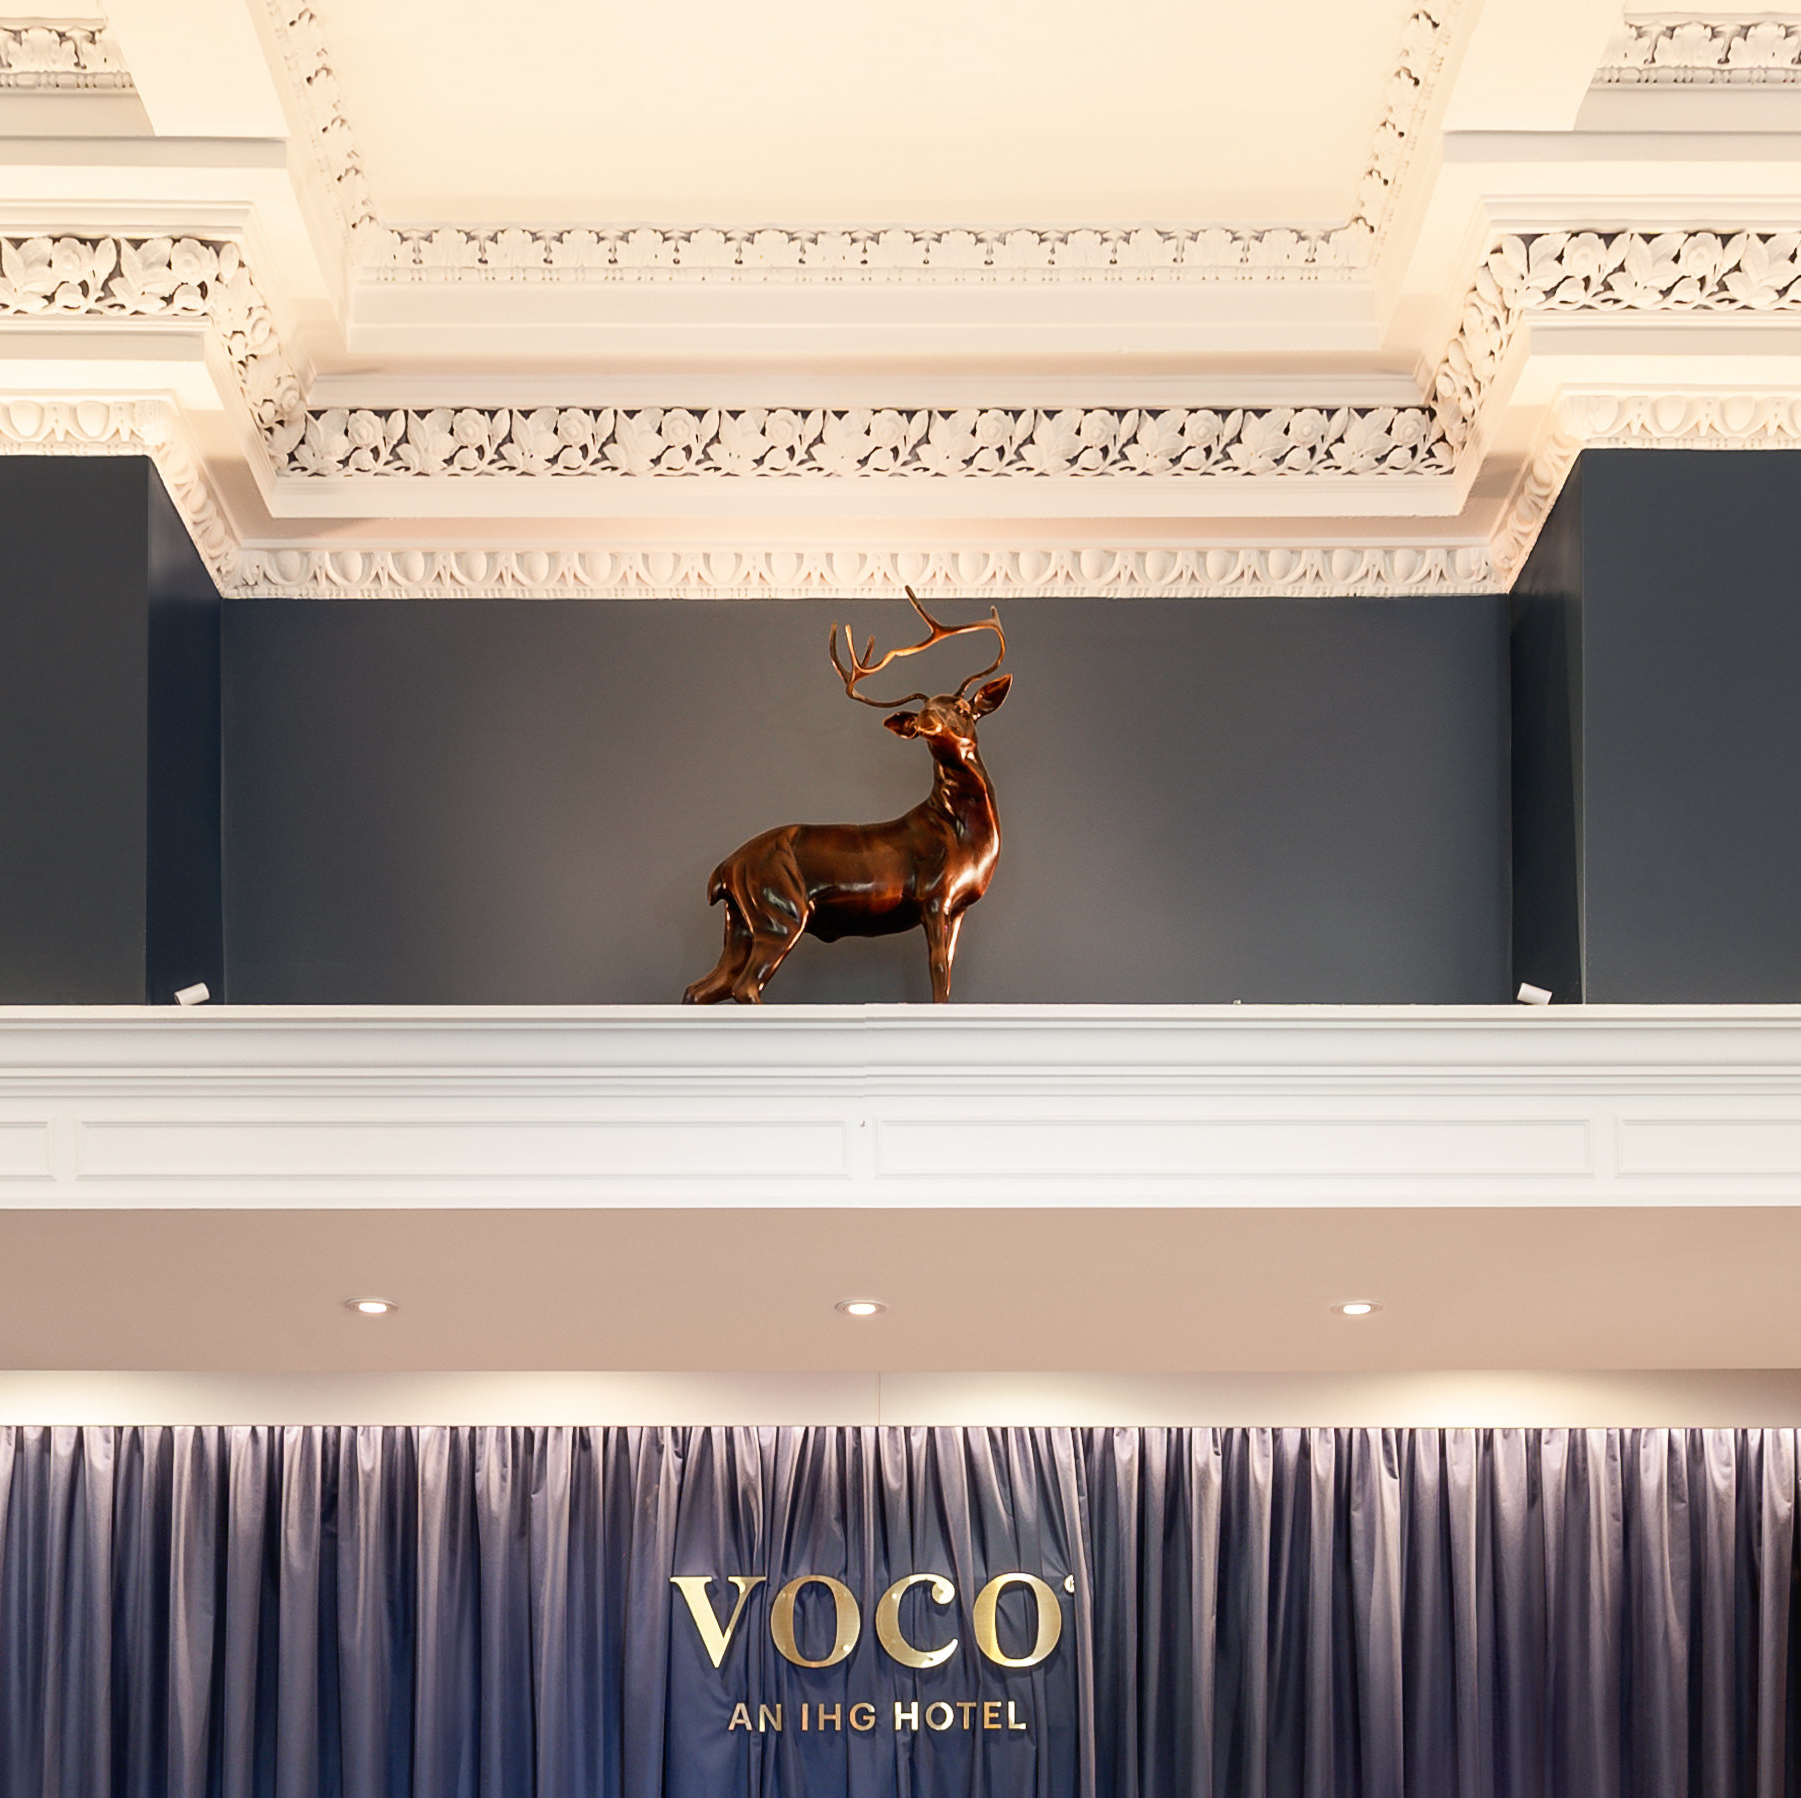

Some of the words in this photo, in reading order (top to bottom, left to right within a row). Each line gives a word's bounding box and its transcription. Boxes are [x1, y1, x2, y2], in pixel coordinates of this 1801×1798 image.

[728, 1702, 782, 1732] AN
[801, 1702, 876, 1731] IHG
[894, 1701, 1027, 1731] HOTEL
